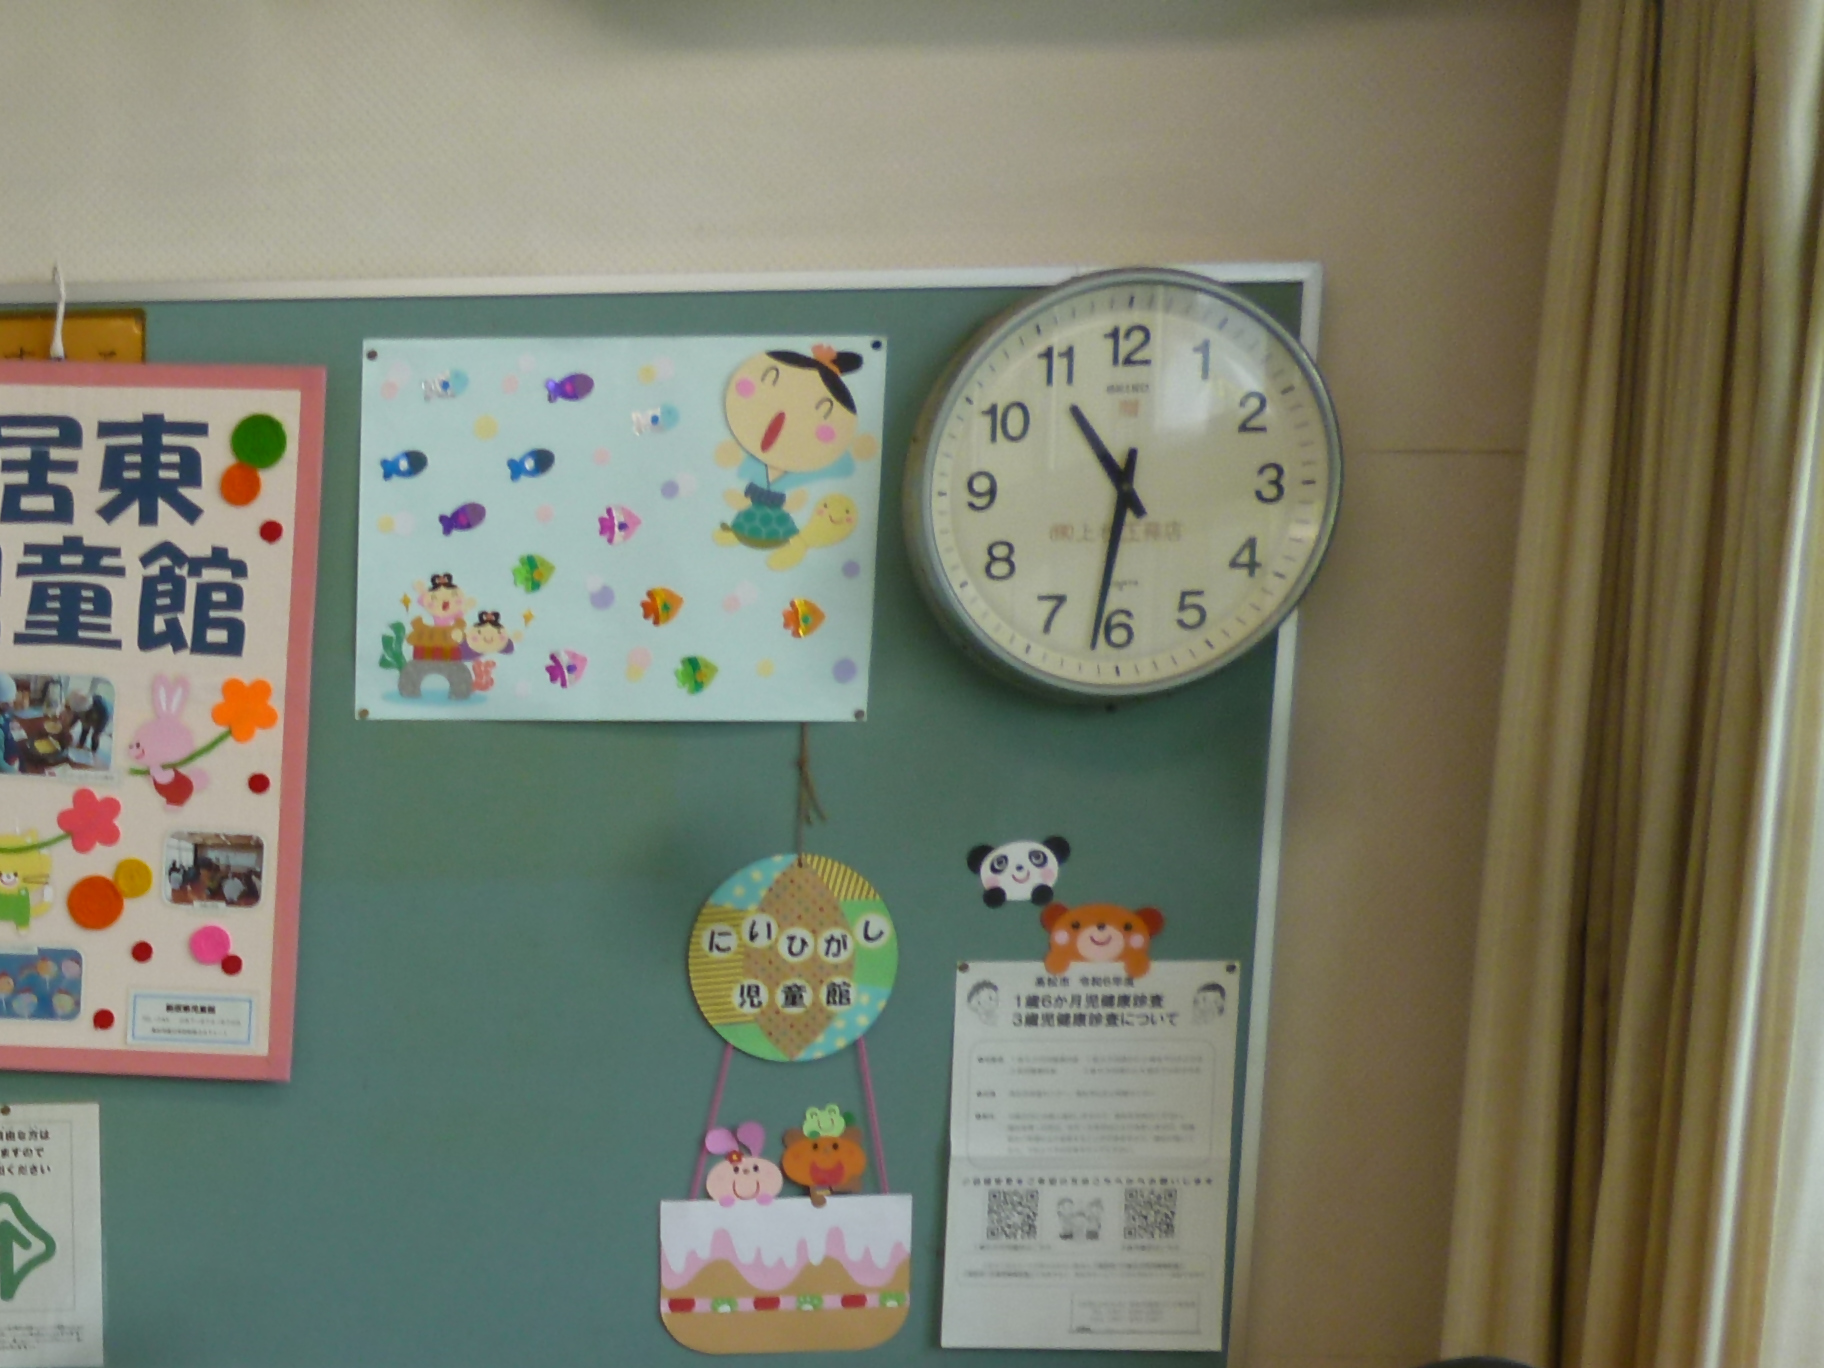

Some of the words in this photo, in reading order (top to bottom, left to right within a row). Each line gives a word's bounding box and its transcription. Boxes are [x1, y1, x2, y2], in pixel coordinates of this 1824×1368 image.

[1037, 345, 1076, 387] 11
[1104, 324, 1152, 368] 12
[1192, 338, 1212, 381] 1
[981, 402, 1030, 443] 10
[1238, 391, 1268, 434] 2
[966, 471, 998, 511] 9
[1255, 463, 1286, 504] 3
[984, 541, 1016, 581] 8
[1228, 537, 1263, 578] 4
[1037, 594, 1068, 634] 7
[1103, 608, 1135, 649] 6
[1176, 590, 1207, 631] 5
[708, 919, 885, 958] にいひがし
[738, 981, 852, 1009] 児童館
[1013, 993, 1165, 1009] 1歳6か月児健康診査
[1012, 1012, 1180, 1028] 3歳児健康診査について
